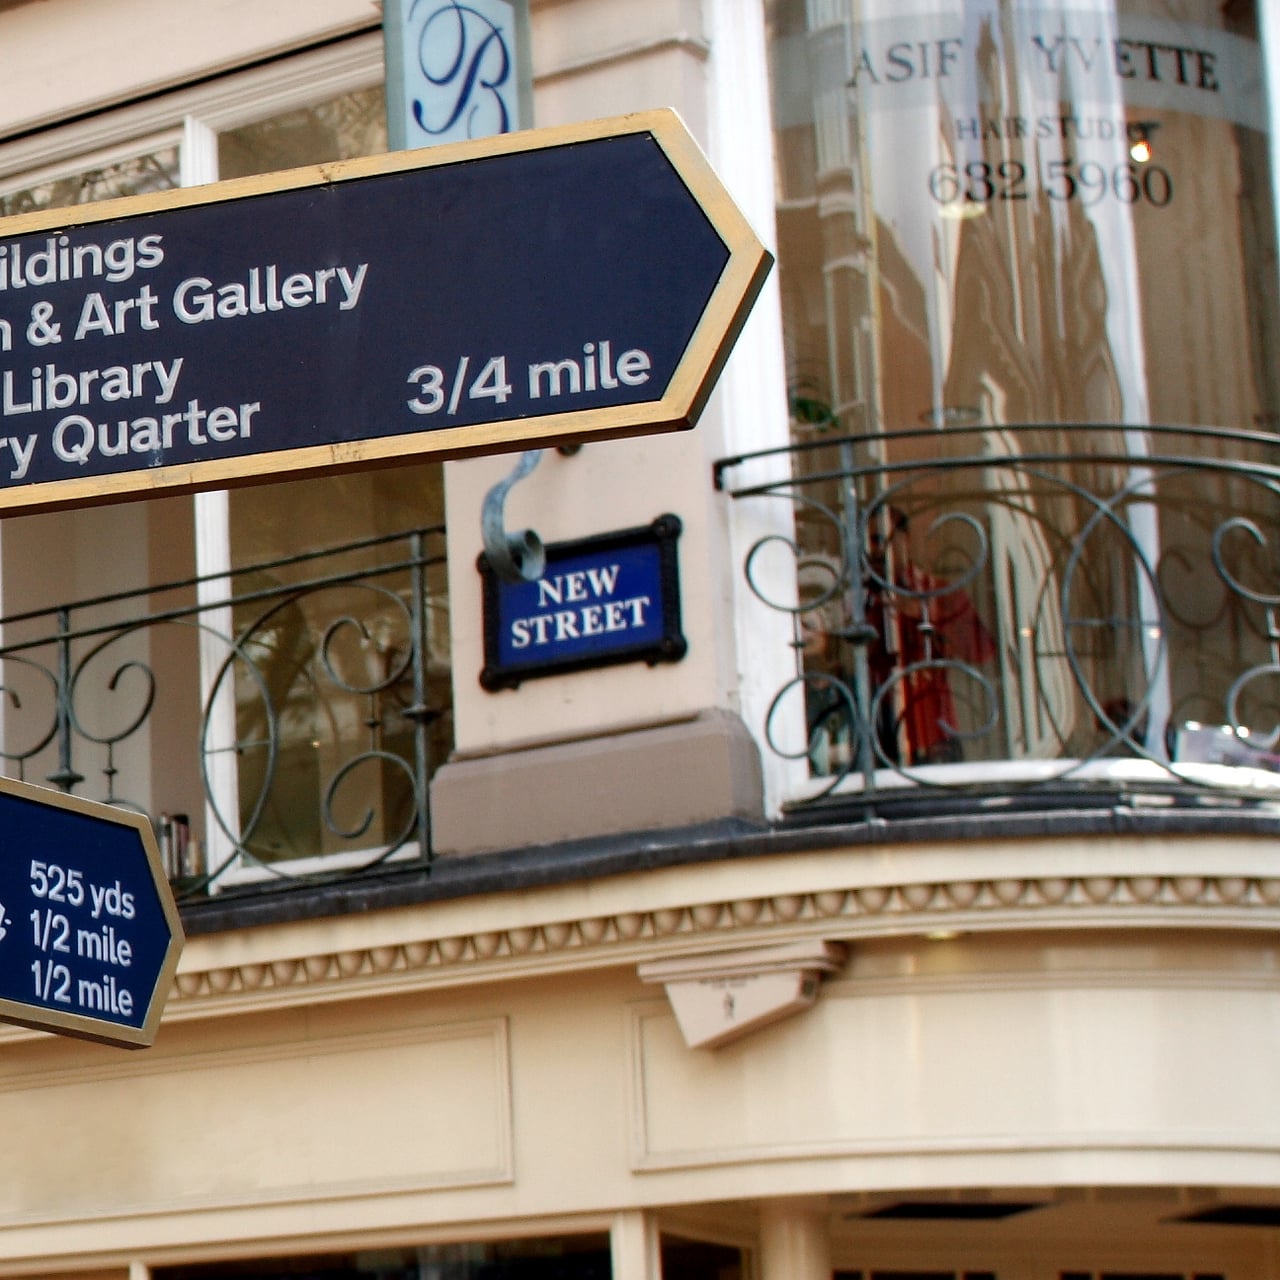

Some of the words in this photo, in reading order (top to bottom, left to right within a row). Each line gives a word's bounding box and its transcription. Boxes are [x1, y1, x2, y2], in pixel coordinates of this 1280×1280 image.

[846, 38, 963, 88] ASIF
[1032, 35, 1221, 93] YVETTE
[929, 160, 1029, 205] 632
[1047, 159, 1173, 208] 5960
[26, 300, 63, 348] &
[75, 290, 160, 341] Art
[172, 263, 370, 324] Gallery
[2, 355, 184, 417] Library
[406, 355, 511, 416] 3/4
[528, 341, 652, 400] mile
[52, 400, 261, 468] Quarter
[537, 564, 620, 608] NEW
[511, 596, 650, 649] STREET
[30, 860, 85, 907] 525
[91, 884, 135, 921] yds
[30, 909, 70, 956] 1/2
[78, 924, 133, 968] mile
[31, 960, 71, 1006] 1/2
[79, 975, 134, 1017] mile
